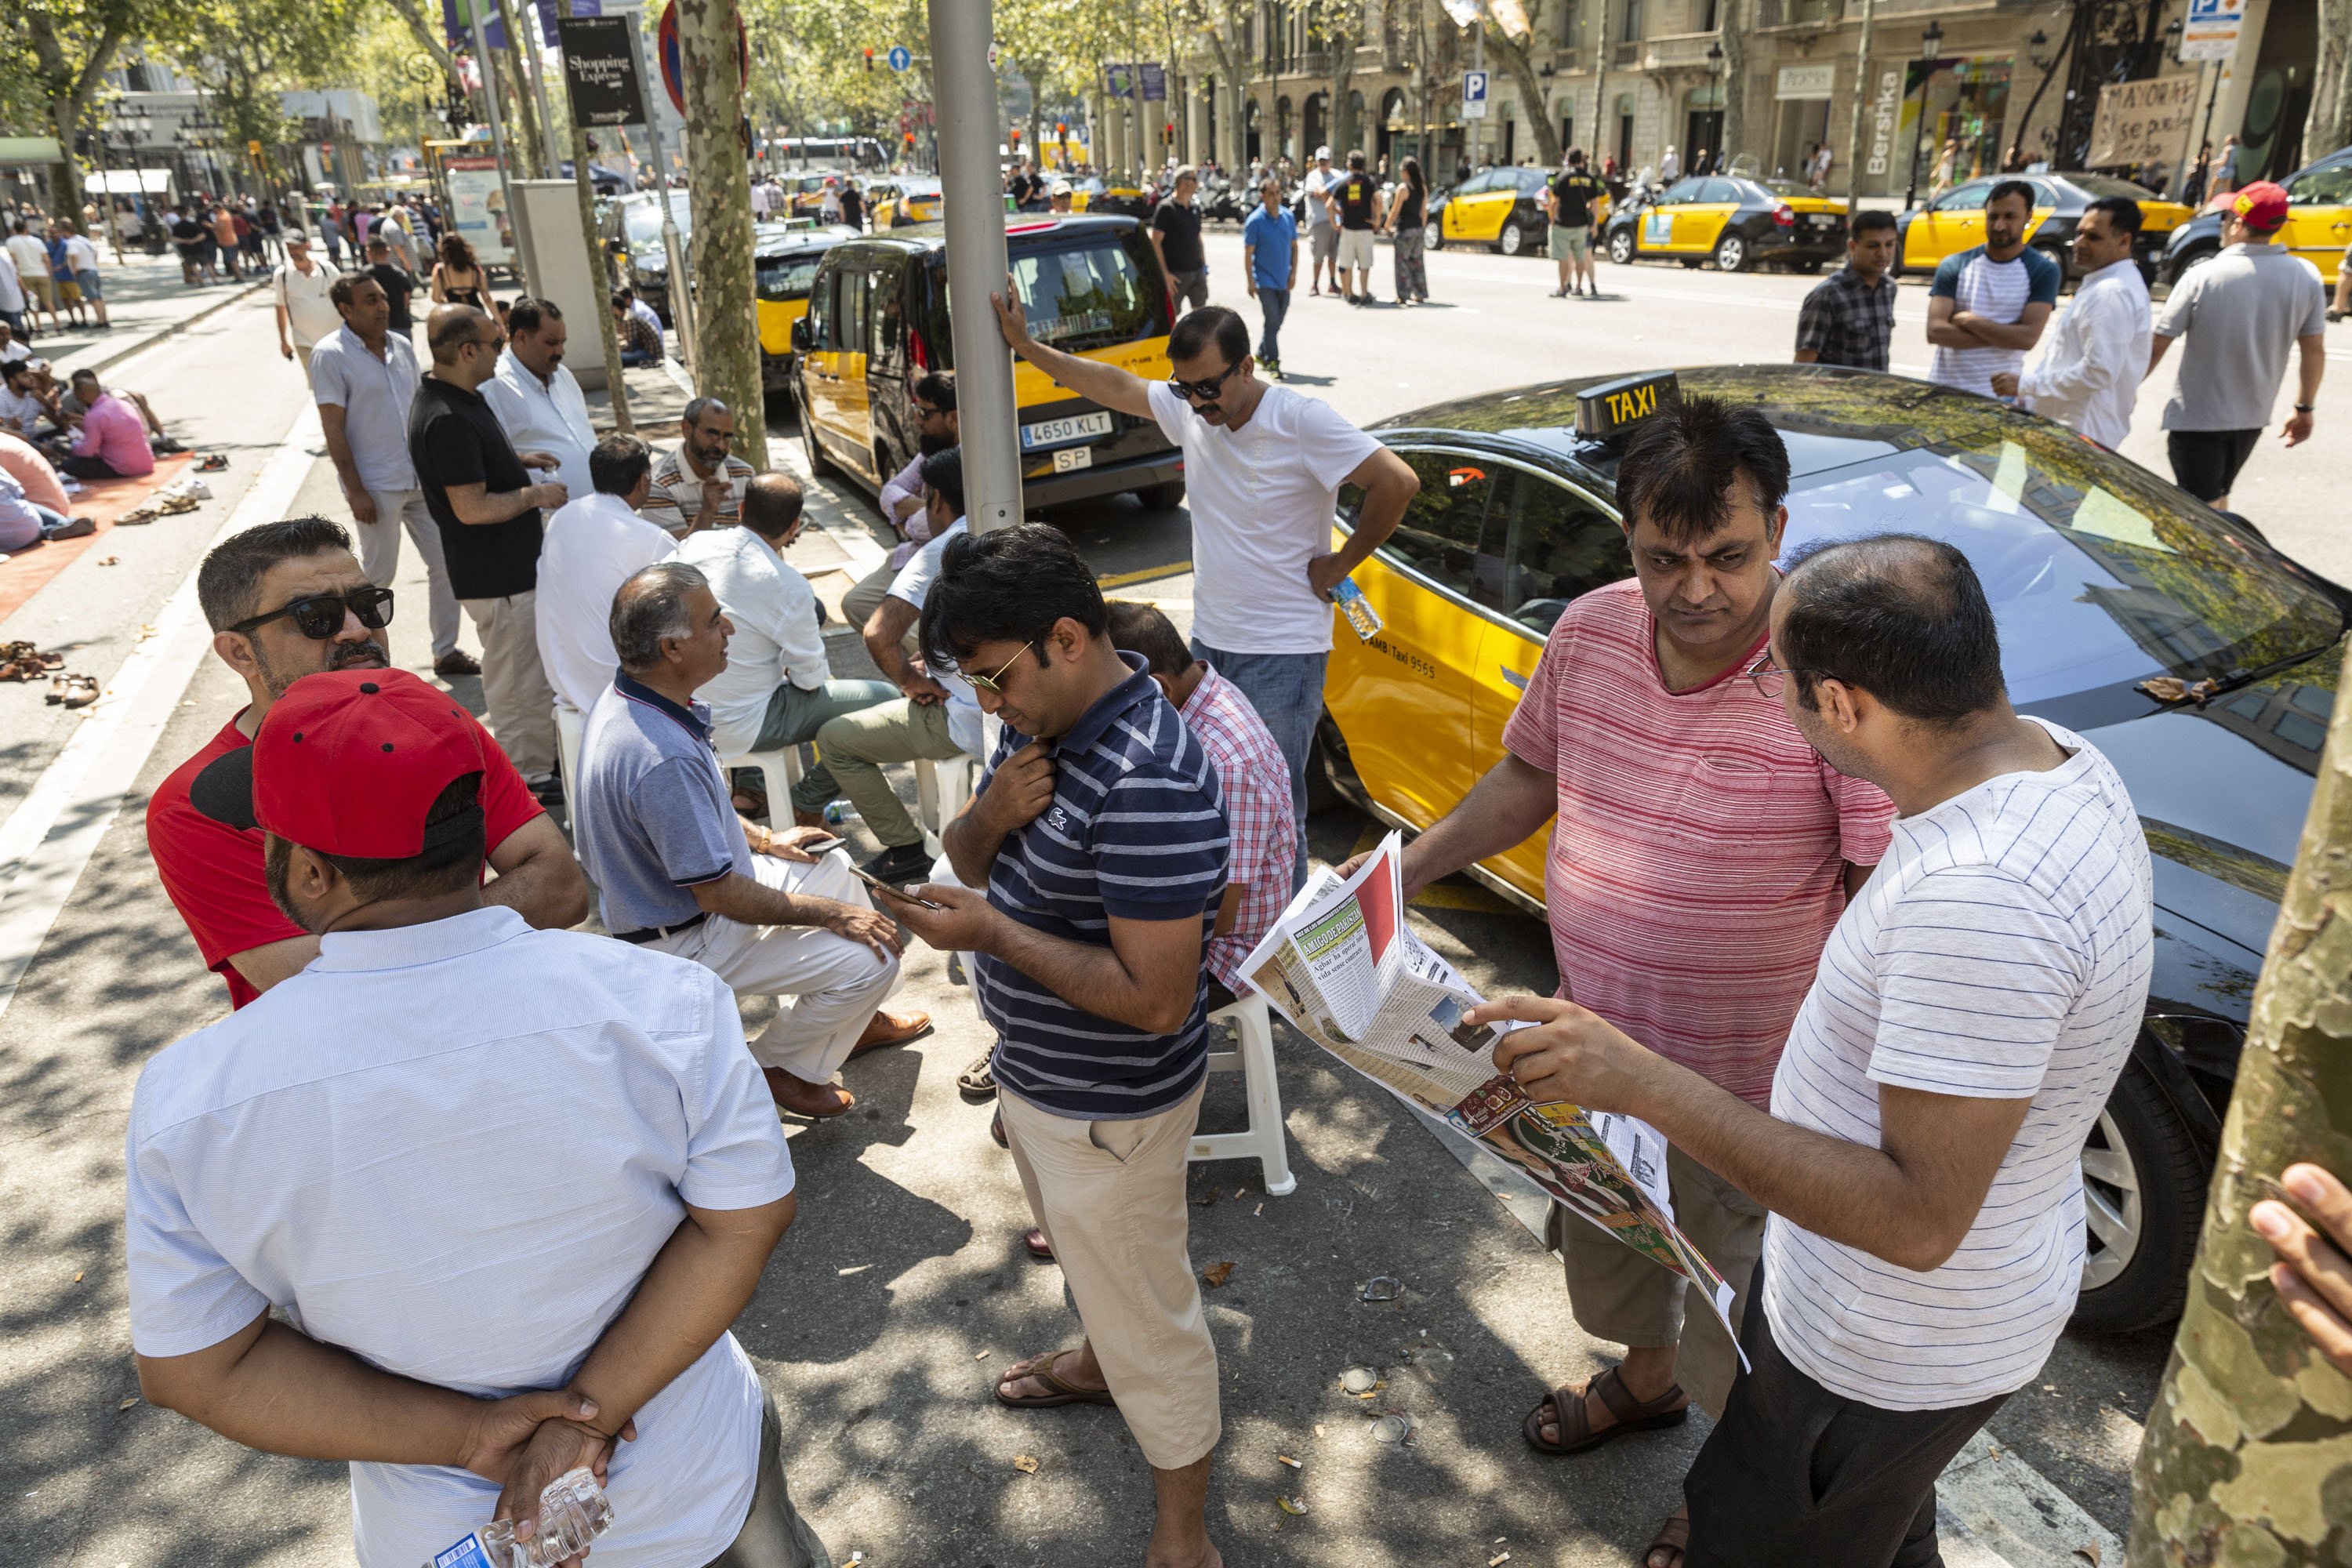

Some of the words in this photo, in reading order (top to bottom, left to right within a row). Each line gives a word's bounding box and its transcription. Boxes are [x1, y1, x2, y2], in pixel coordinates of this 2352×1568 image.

[569, 54, 630, 73] Shopping
[580, 71, 621, 85] Express
[1468, 74, 1484, 100] P
[1867, 71, 1898, 174] Bershka
[1606, 384, 1657, 424] TAXI
[1034, 420, 1073, 441] 4650
[1077, 416, 1105, 433] KLT
[1058, 450, 1086, 469] SP
[1369, 637, 1388, 654] AMB
[1392, 646, 1409, 665] Taxi
[1411, 655, 1435, 679] 9565
[1295, 930, 1305, 938] VOZ
[1303, 932, 1330, 955] AMIGO
[1327, 927, 1339, 941] DE
[1336, 907, 1362, 935] PAKISTAN
[1314, 957, 1332, 972] Agbar
[1342, 941, 1356, 955] operat
[1318, 970, 1332, 981] vida
[1331, 961, 1345, 972] sense
